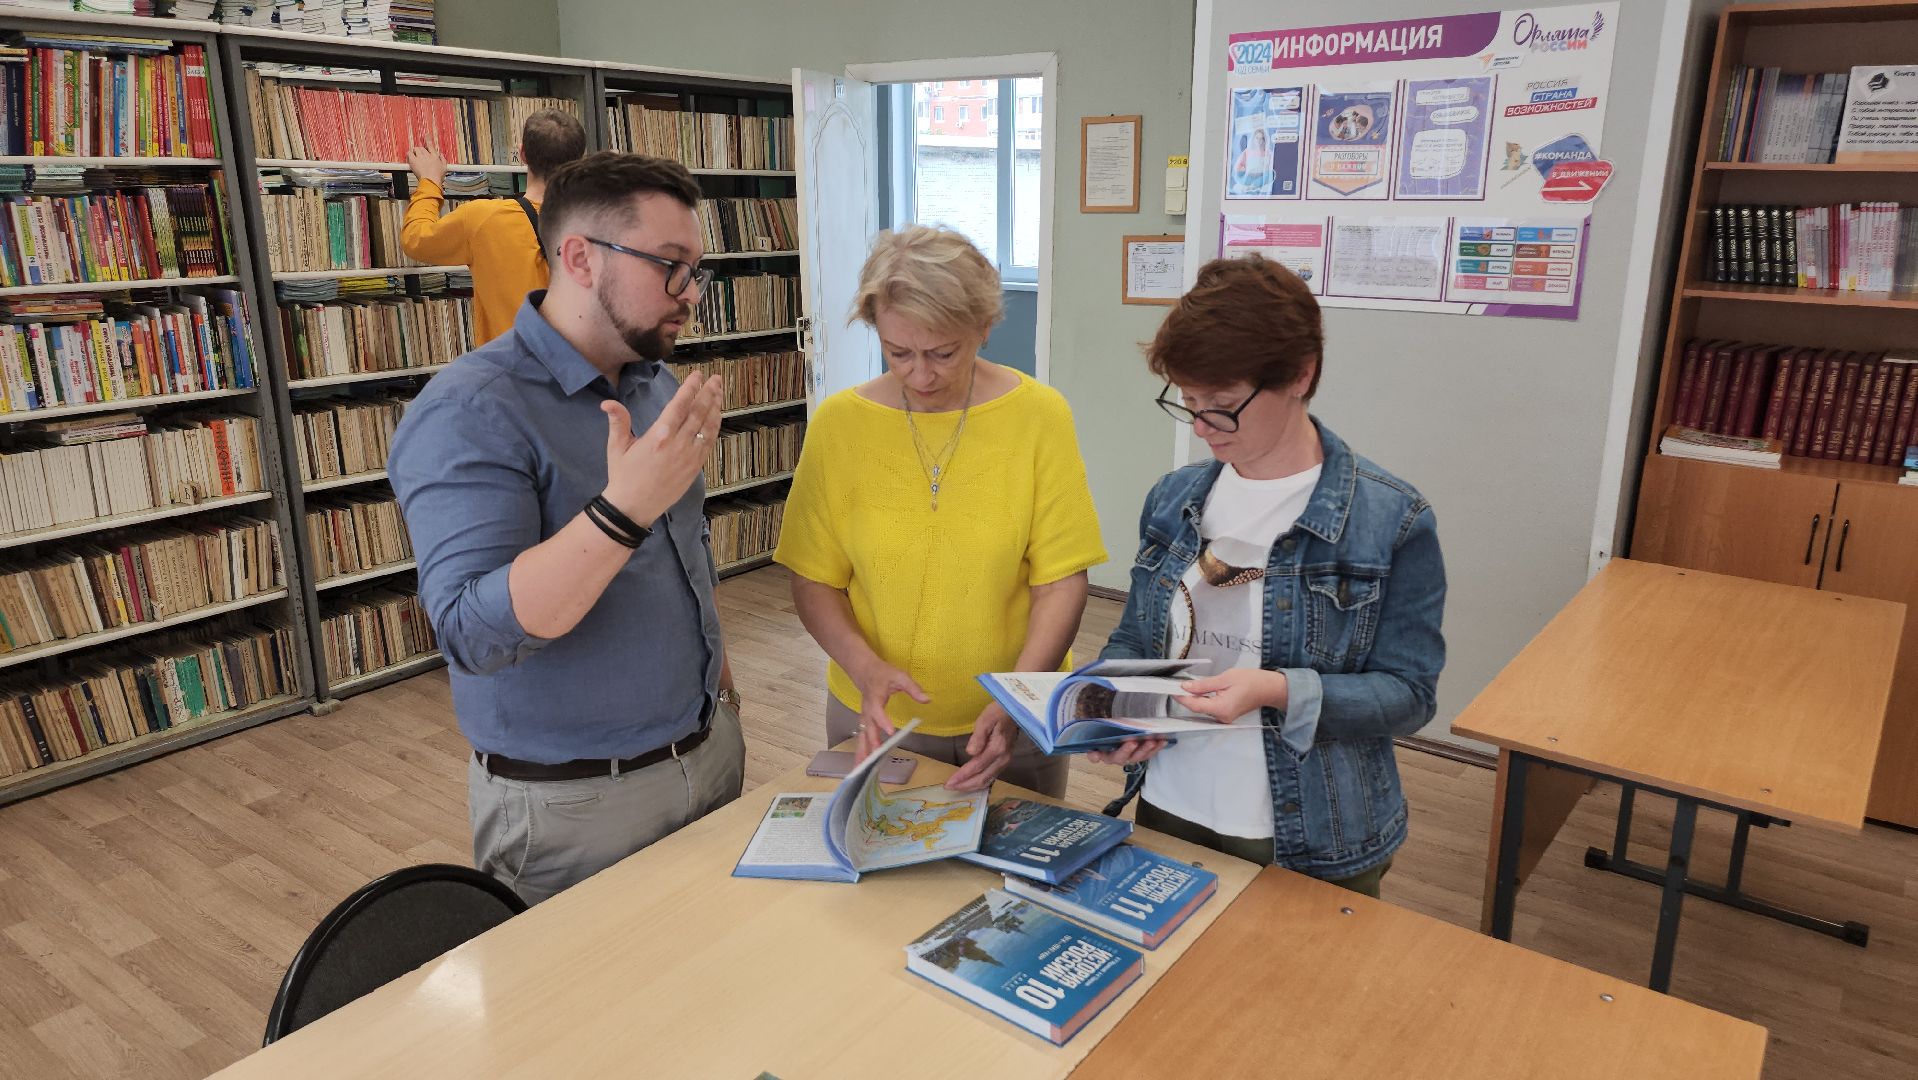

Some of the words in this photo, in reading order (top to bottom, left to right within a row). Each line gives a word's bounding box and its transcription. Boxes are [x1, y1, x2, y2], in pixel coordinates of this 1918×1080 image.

[1273, 24, 1443, 58] ИНФОРМАЦИЯ
[1514, 13, 1589, 48] Орлята
[1236, 42, 1271, 64] 2024
[1531, 39, 1588, 53] РОССИИ
[1526, 79, 1568, 90] РОССИЯ
[1532, 90, 1573, 101] СТРАНА
[1507, 98, 1592, 116] ВОЗМОЖНОСТЕЙ
[1534, 151, 1592, 160] #КОМАНДА
[1041, 819, 1089, 846] ИСТОРИЯ
[1019, 847, 1060, 863] 11
[1128, 864, 1176, 897] РОССИИ
[1148, 870, 1192, 904] ИСТОРИЯ
[1110, 896, 1154, 921] 11
[1039, 940, 1096, 982] РОССИИ
[1058, 947, 1113, 989] ИСТОРИЯ
[1016, 978, 1065, 1010] 10
